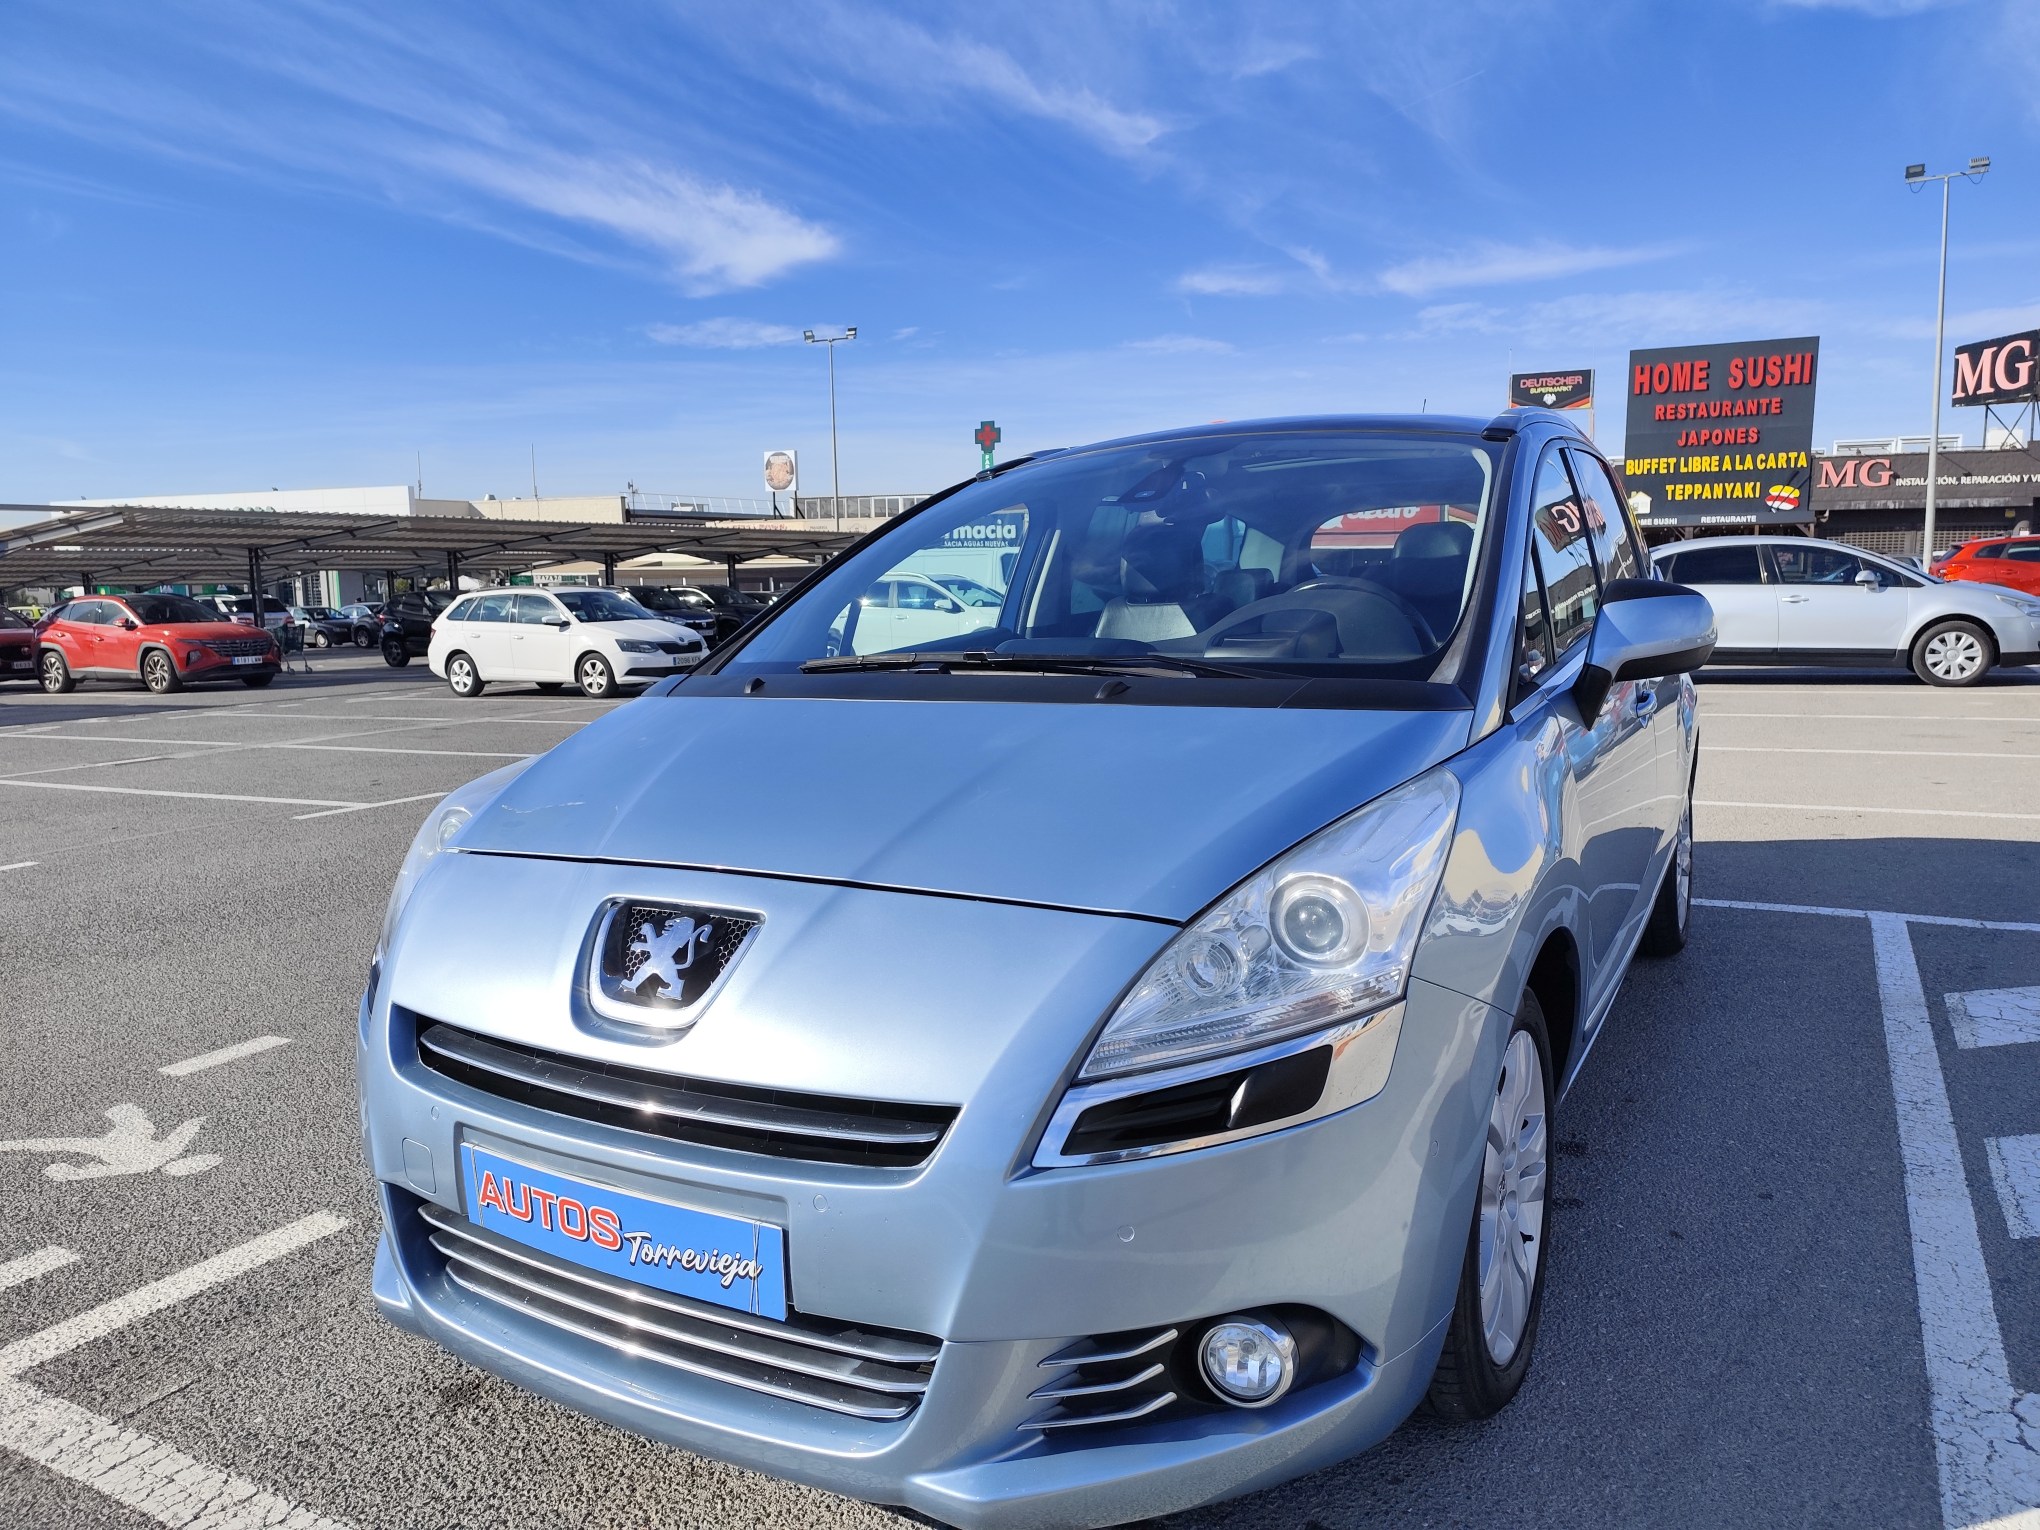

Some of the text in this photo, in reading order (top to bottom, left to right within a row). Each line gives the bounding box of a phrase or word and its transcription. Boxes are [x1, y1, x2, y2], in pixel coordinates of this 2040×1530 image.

[1633, 352, 1812, 395] HOME SUSHI
[1952, 340, 2034, 399] MG
[1520, 375, 1583, 388] DEUTSCHER
[1530, 385, 1573, 394] SUPERMARKT
[1655, 397, 1782, 420] RESTAURANTE
[1677, 427, 1759, 447] JAPONES
[1626, 451, 1808, 475] BUFFET LIBRE A LA CARTA
[1816, 458, 1894, 489] MG
[1895, 475, 1959, 487] INSTALIÓN,
[1961, 473, 2021, 485] REPARACIÓN
[2022, 474, 2030, 483] Y
[1665, 482, 1761, 501] TEPPANYAKI
[1653, 518, 1678, 526] SUSHI
[1701, 515, 1757, 524] RESTAURANTE
[963, 540, 984, 548] AGUAS
[479, 1170, 763, 1289] AUTOS Torrevieja
